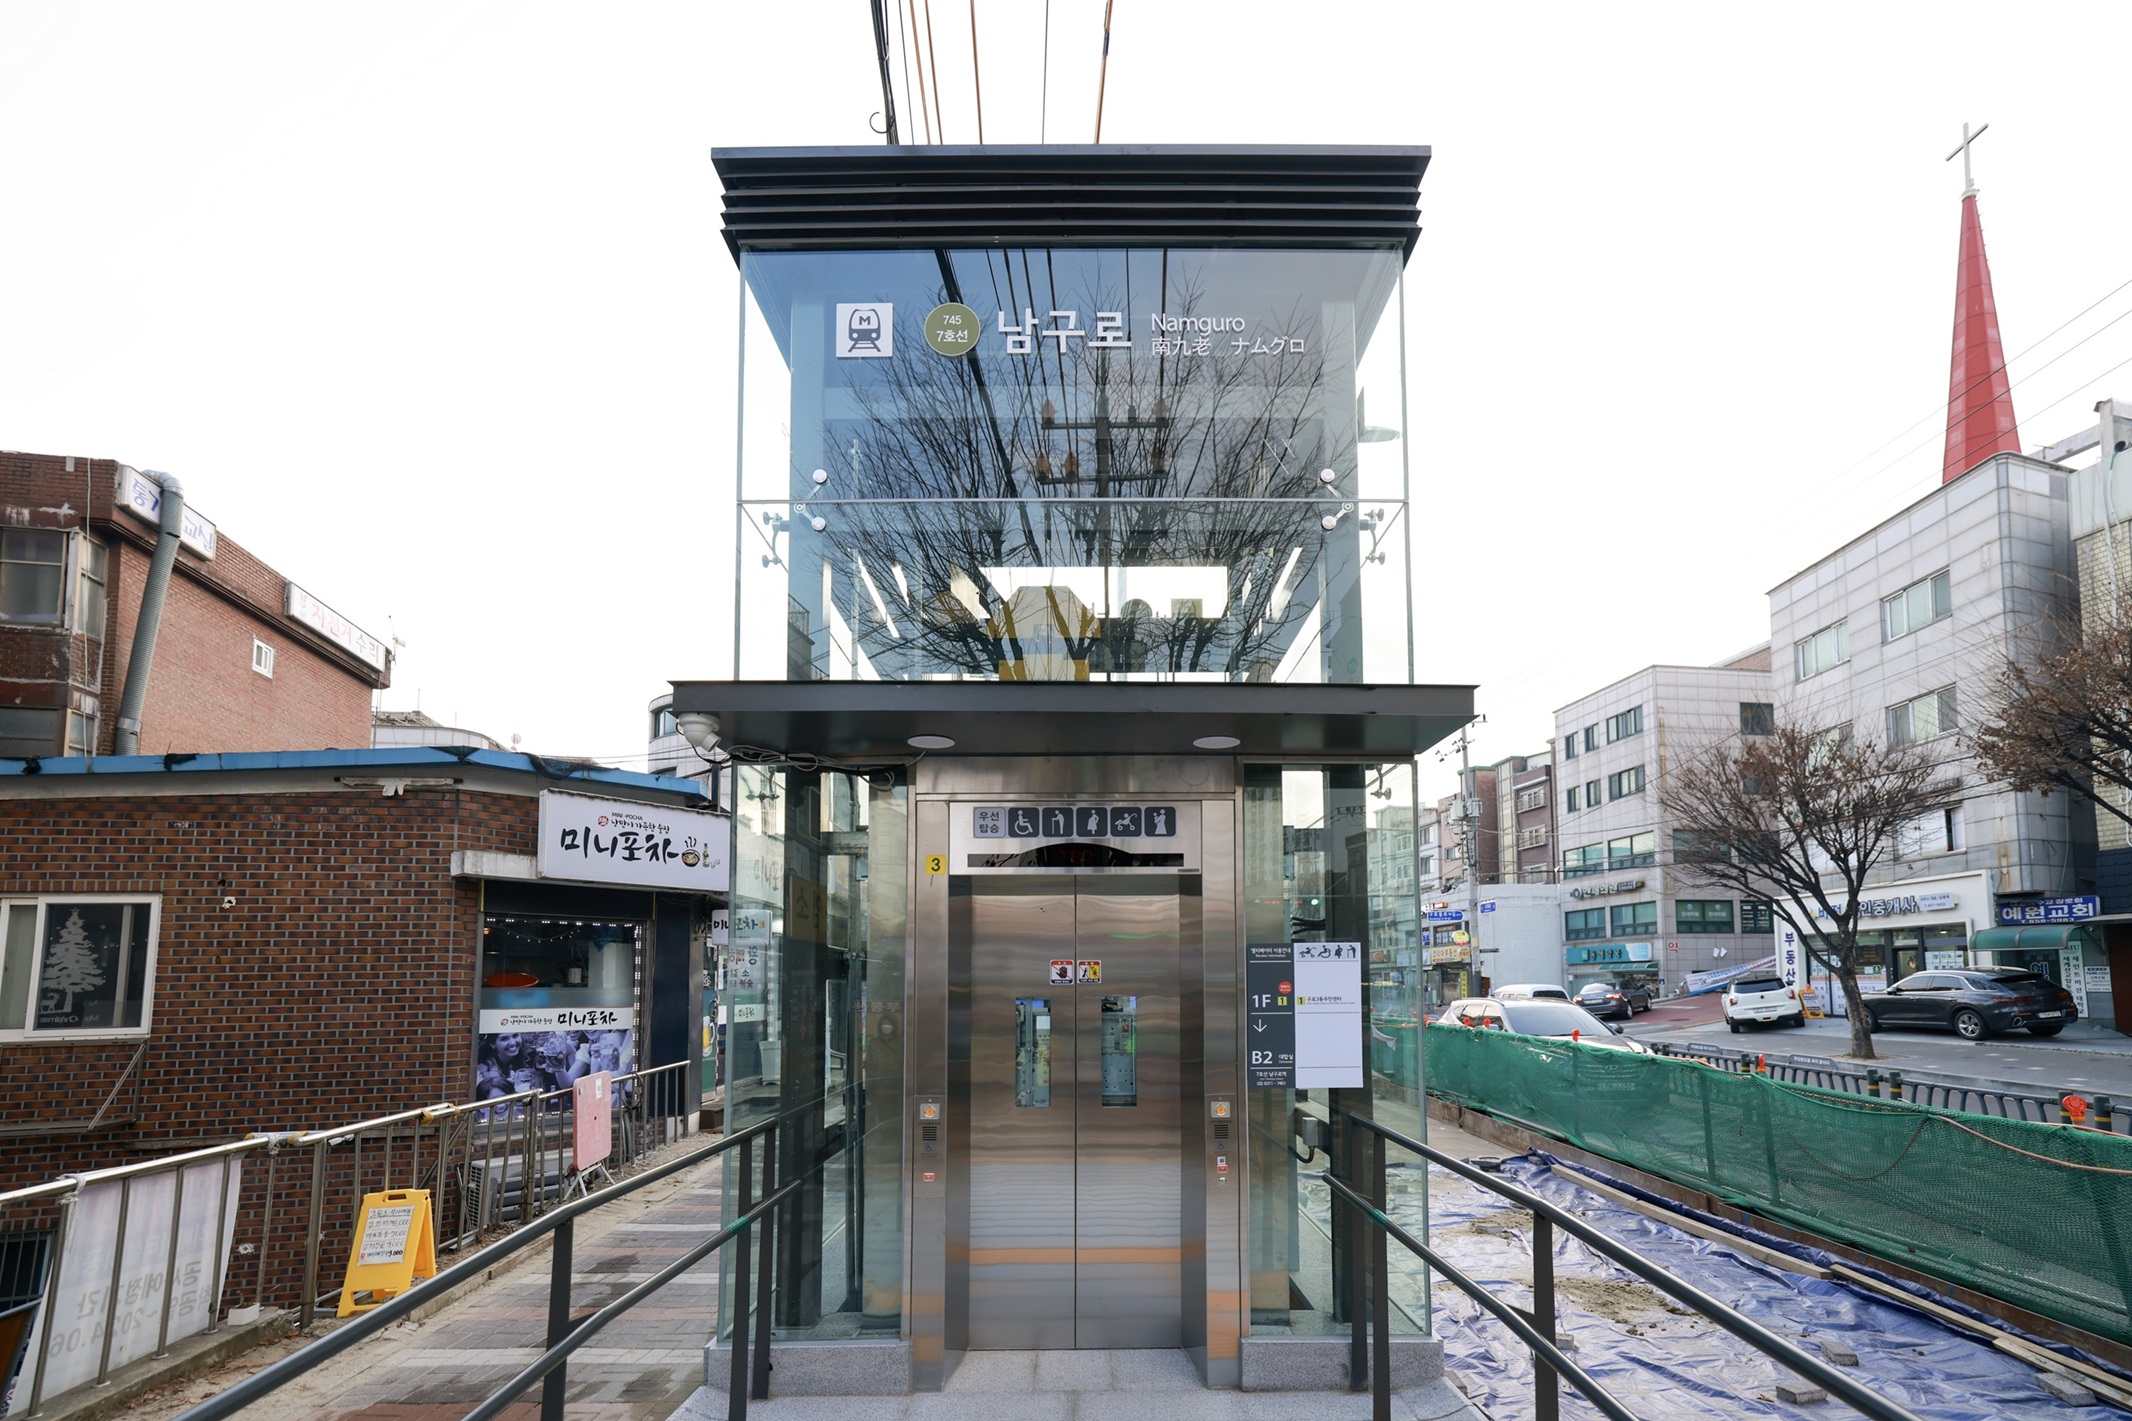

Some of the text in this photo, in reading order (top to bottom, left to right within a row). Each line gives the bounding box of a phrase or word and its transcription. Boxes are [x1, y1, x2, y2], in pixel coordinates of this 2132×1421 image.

[943, 314, 962, 325] 745
[1151, 313, 1246, 334] Namguro
[936, 328, 969, 344] 7호선
[998, 308, 1132, 355] 남구로
[1151, 337, 1211, 356] 南九老
[1230, 338, 1306, 356] ナムグロ
[312, 603, 379, 665] 자전거 수리
[979, 811, 1000, 822] 우선
[979, 823, 1000, 834] 탑승
[561, 826, 680, 864] 미니포차
[931, 858, 941, 872] 3
[1852, 895, 1918, 918] 인중개사
[2002, 903, 2094, 920] 예원교회
[1668, 942, 1679, 954] 약
[1784, 932, 1797, 986] 부동산
[1252, 994, 1271, 1008] 1F
[558, 1011, 618, 1027] 미니포차
[1252, 1050, 1273, 1064] B2
